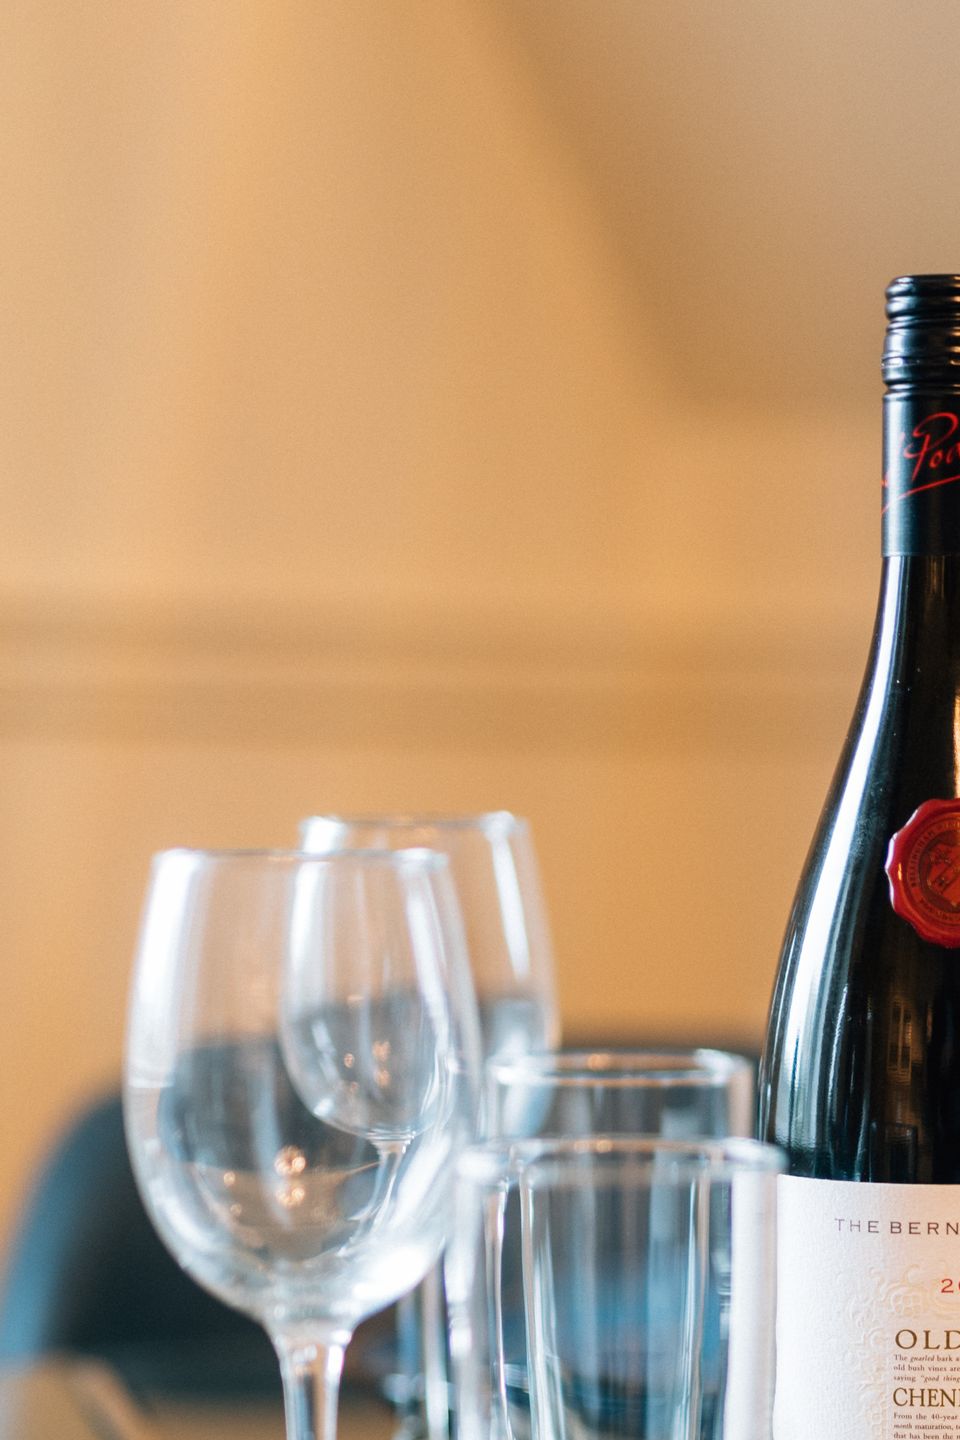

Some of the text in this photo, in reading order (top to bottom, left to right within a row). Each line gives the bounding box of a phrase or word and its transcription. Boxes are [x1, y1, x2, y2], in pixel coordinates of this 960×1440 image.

[834, 1218, 880, 1233] THE
[910, 1354, 934, 1362] gnarled
[931, 1413, 958, 1422] 40-year
